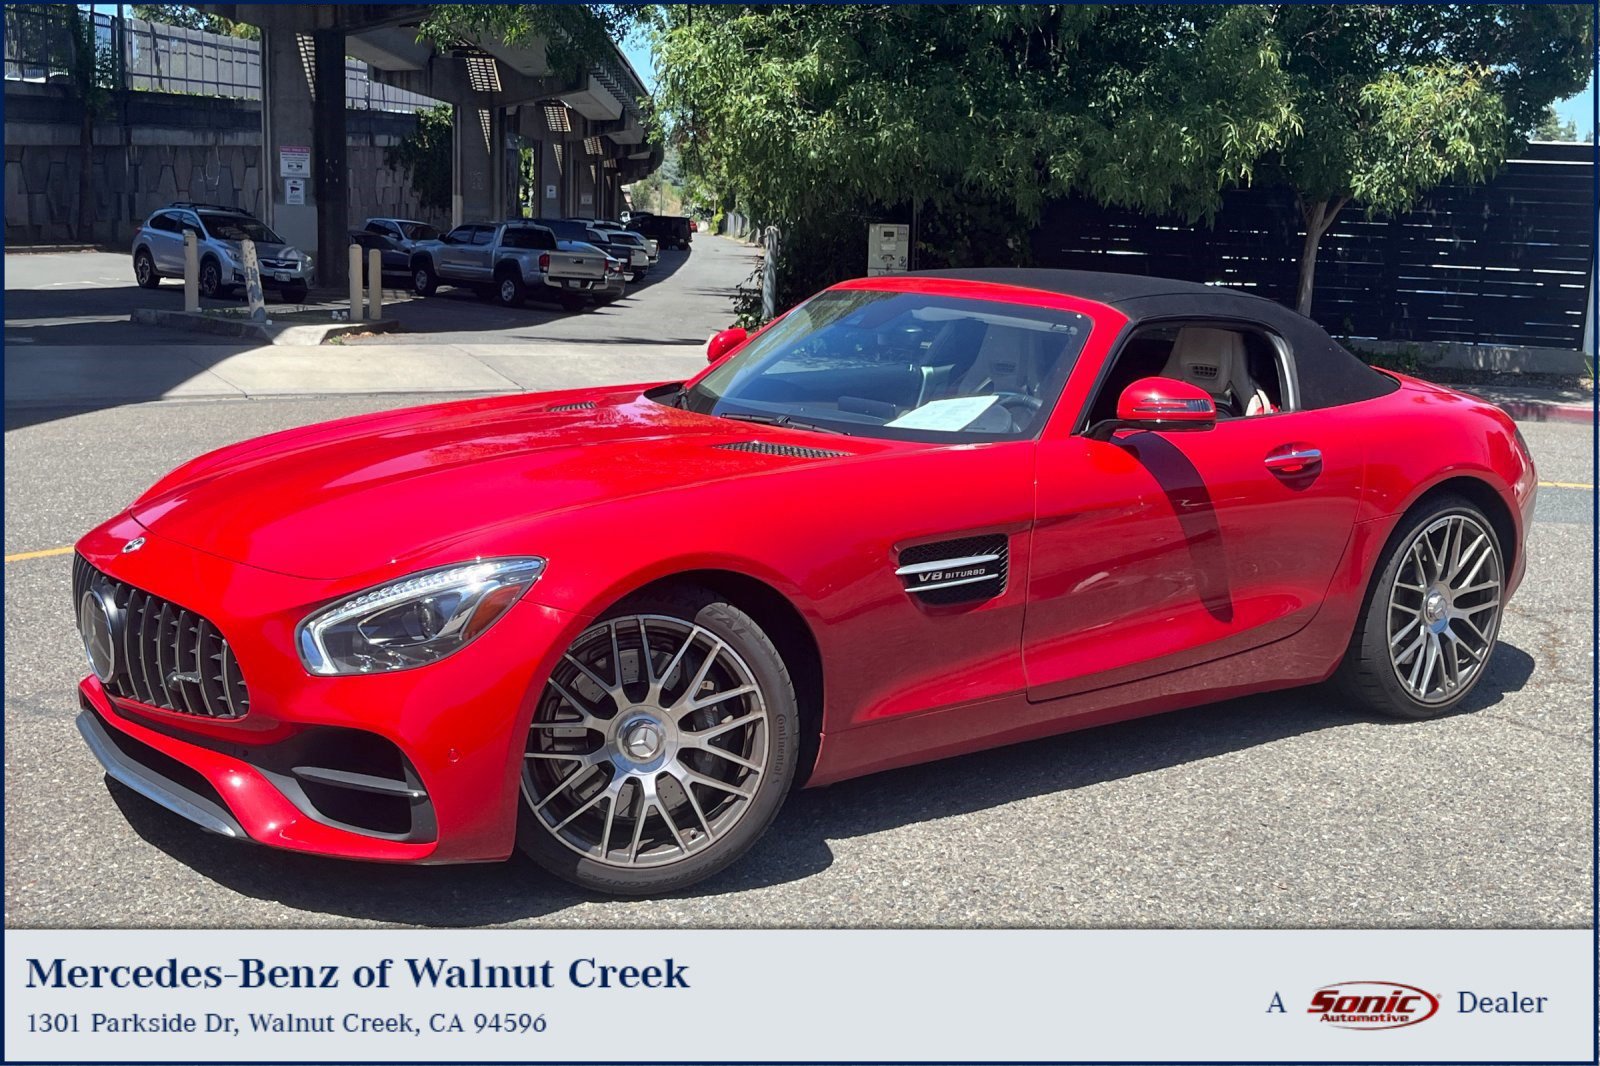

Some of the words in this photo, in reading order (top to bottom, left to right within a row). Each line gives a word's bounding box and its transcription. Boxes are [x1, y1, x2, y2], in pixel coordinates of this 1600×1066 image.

[918, 571, 943, 582] V8
[945, 568, 986, 579] BITURBO
[774, 713, 787, 775] Continental
